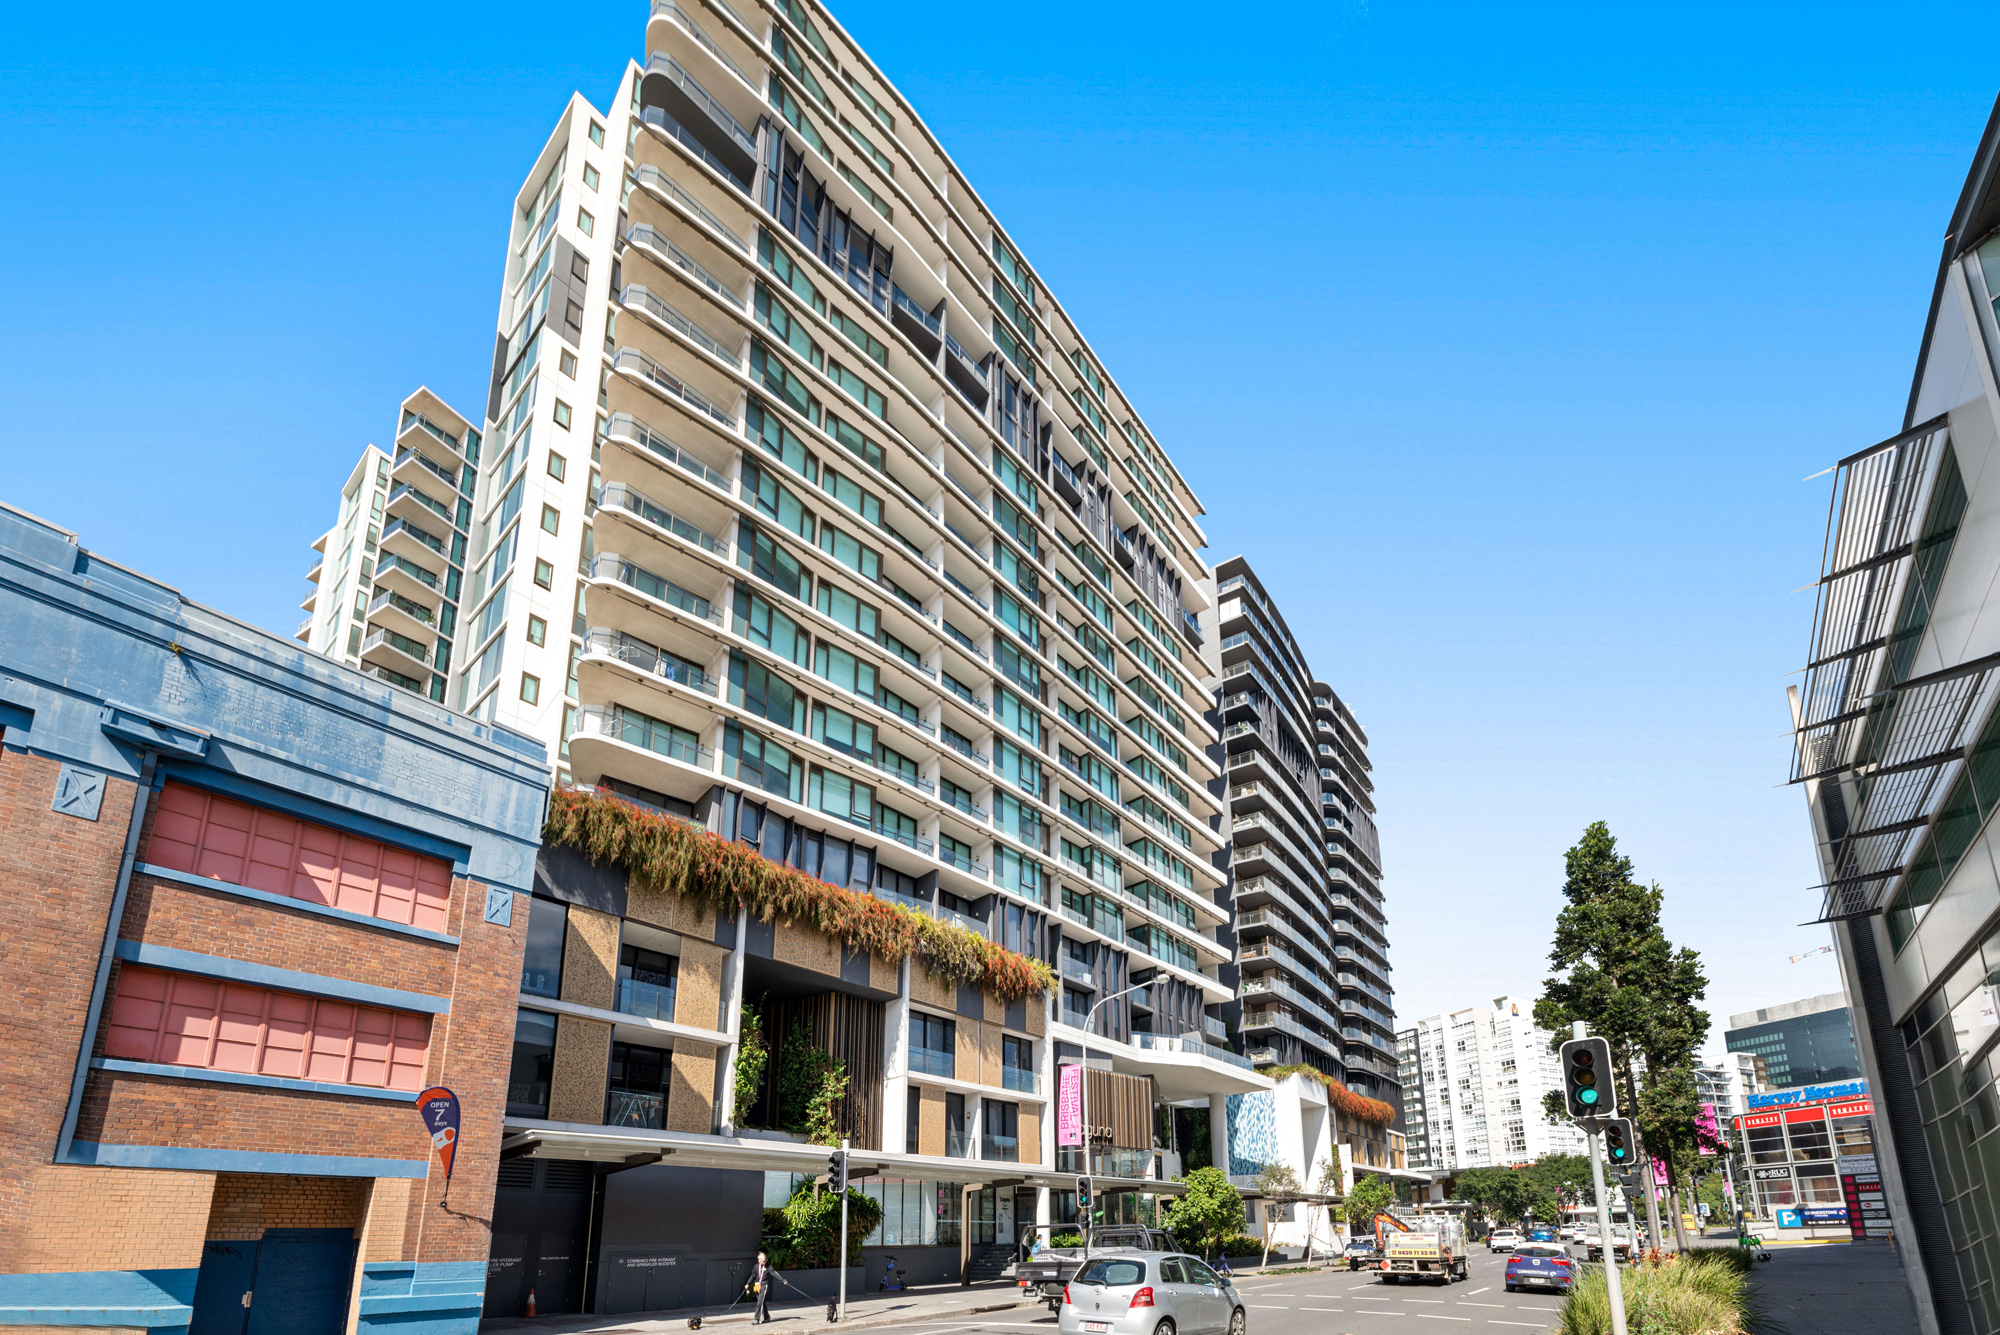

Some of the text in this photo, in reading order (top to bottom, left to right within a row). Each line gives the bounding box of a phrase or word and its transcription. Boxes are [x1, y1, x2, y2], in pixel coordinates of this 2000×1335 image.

[1070, 1069, 1079, 1120] FESTIVAL
[1747, 1090, 1802, 1106] Harvey
[1816, 1094, 1867, 1105] ELECTRICA
[1061, 1074, 1070, 1129] BRISBANE
[435, 1109, 445, 1121] 7
[1771, 1168, 1788, 1176] RUG
[1782, 1212, 1796, 1225] P
